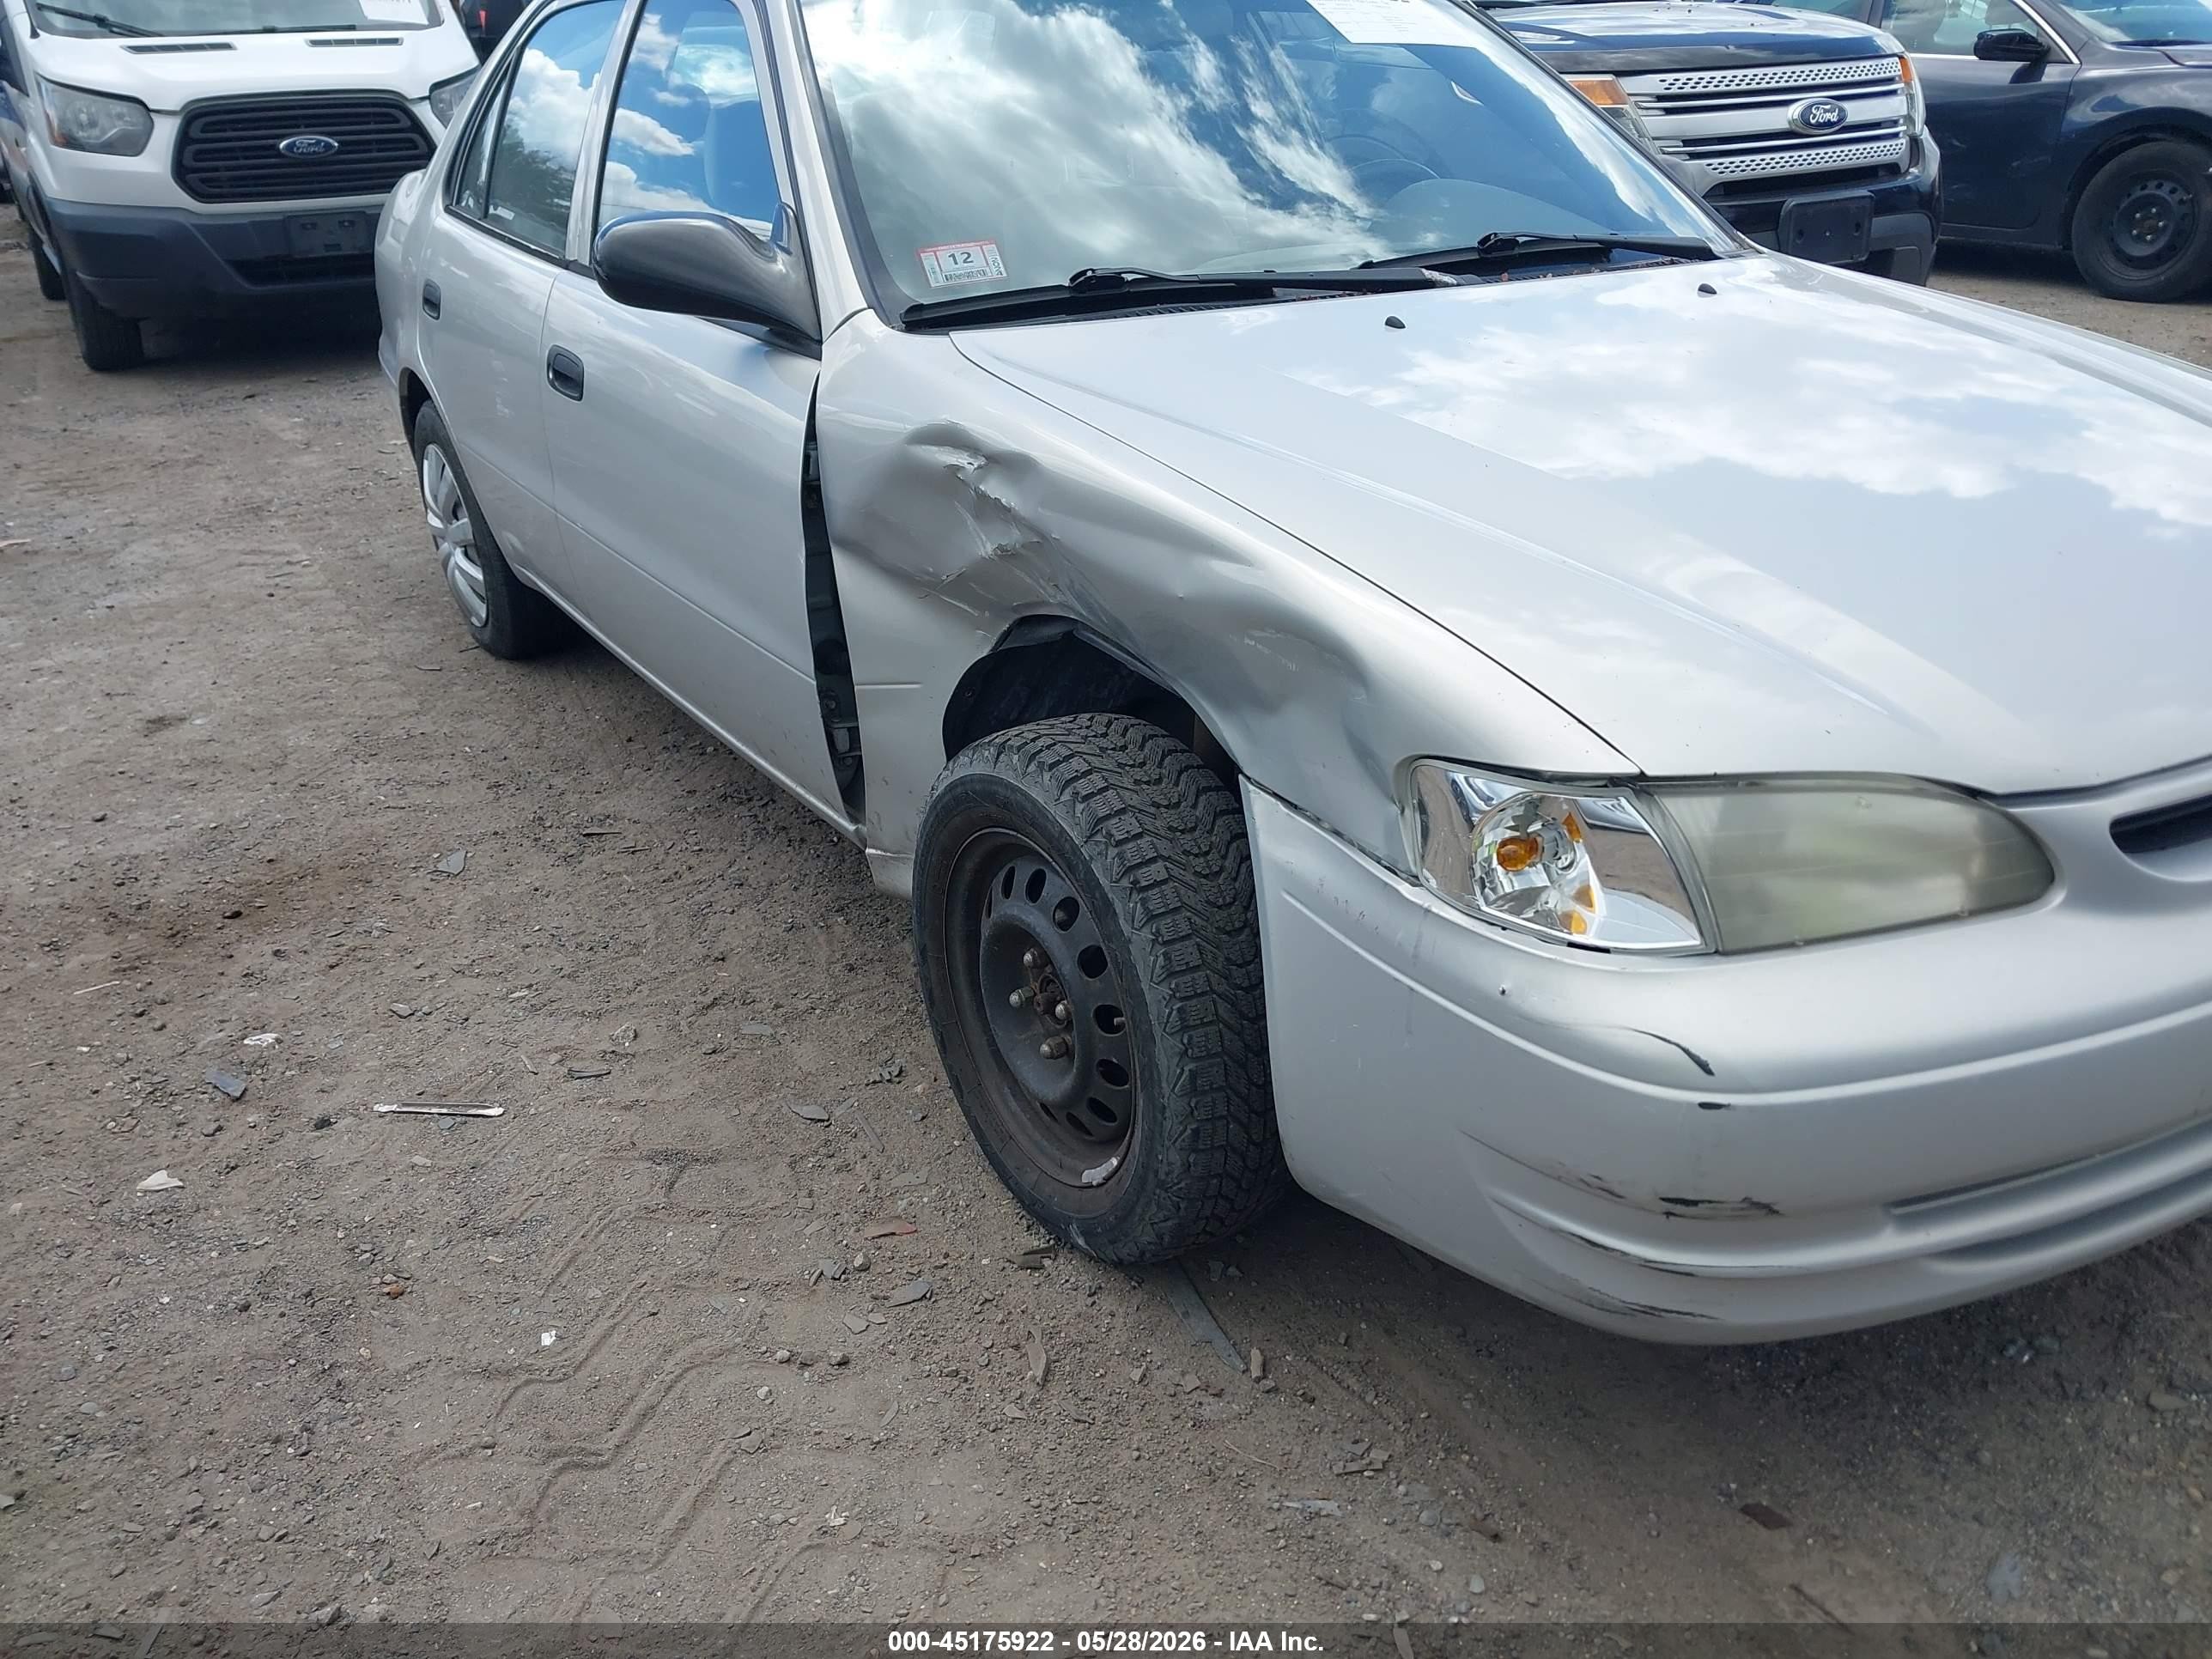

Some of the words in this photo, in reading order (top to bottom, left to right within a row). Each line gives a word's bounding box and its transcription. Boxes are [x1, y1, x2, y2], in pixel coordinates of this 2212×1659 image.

[1809, 104, 1839, 125] Ford
[293, 139, 325, 154] Ford
[948, 251, 975, 265] 12
